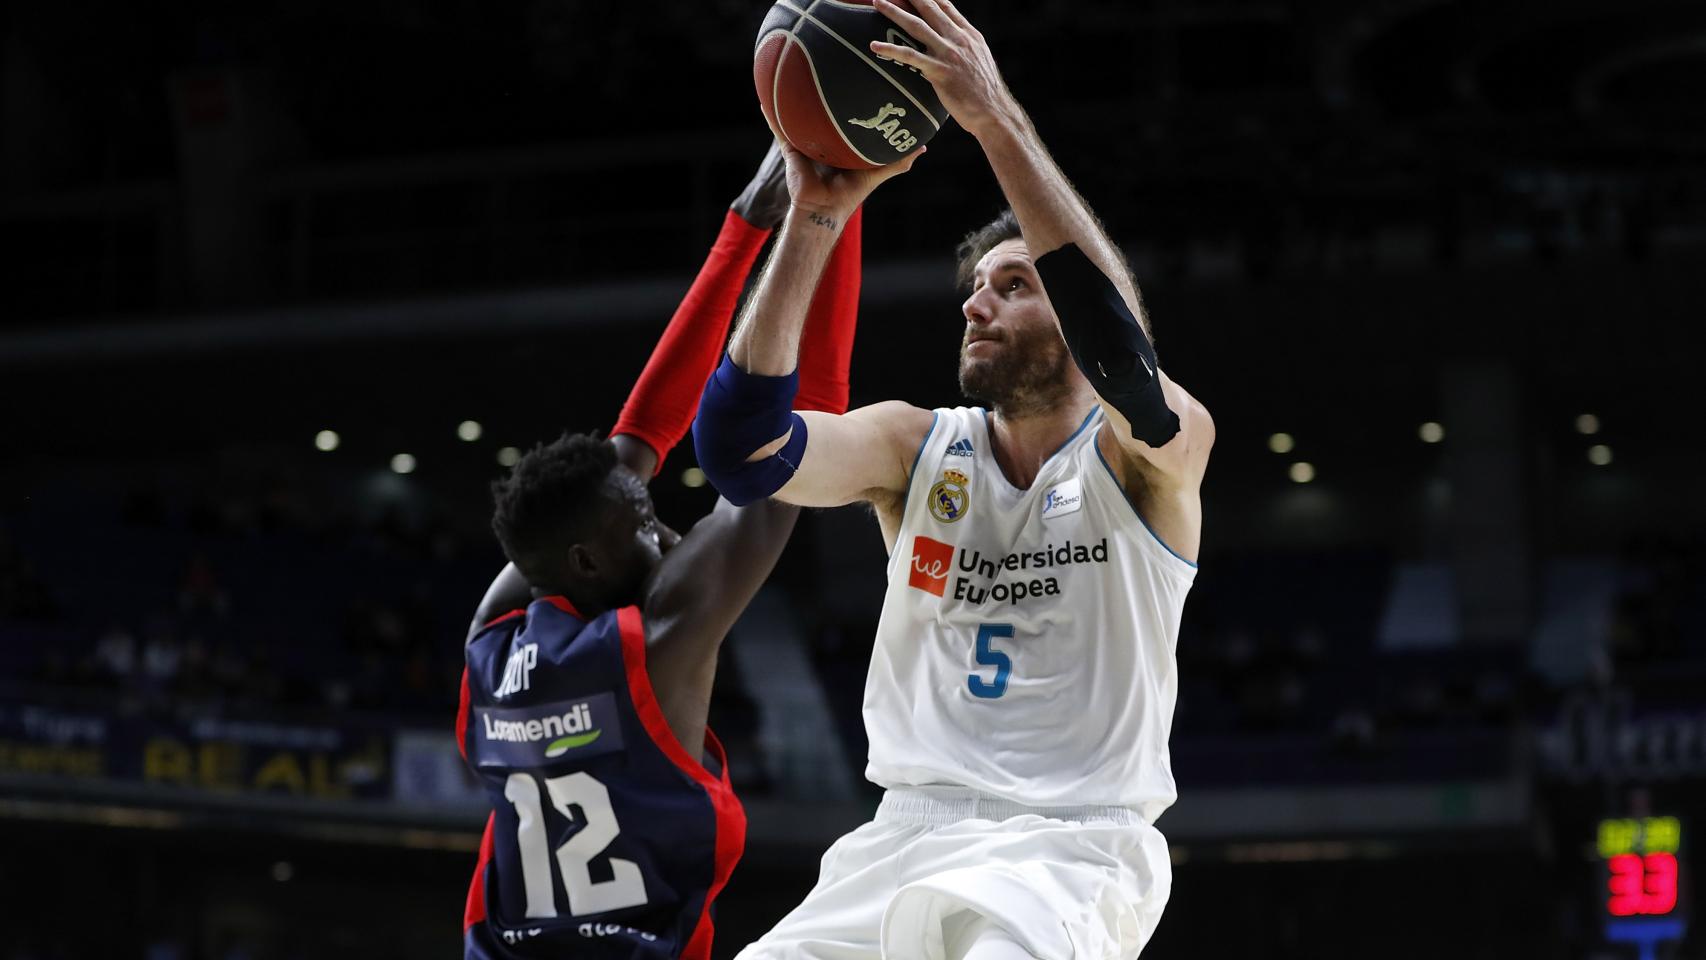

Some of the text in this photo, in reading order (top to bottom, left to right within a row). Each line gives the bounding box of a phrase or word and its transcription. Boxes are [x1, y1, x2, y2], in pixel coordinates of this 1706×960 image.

[875, 118, 918, 153] ACB
[958, 537, 1109, 580] Unersidad
[967, 622, 1015, 699] 5
[483, 703, 592, 743] Loramendi
[504, 771, 648, 919] 12
[1606, 850, 1679, 917] 33
